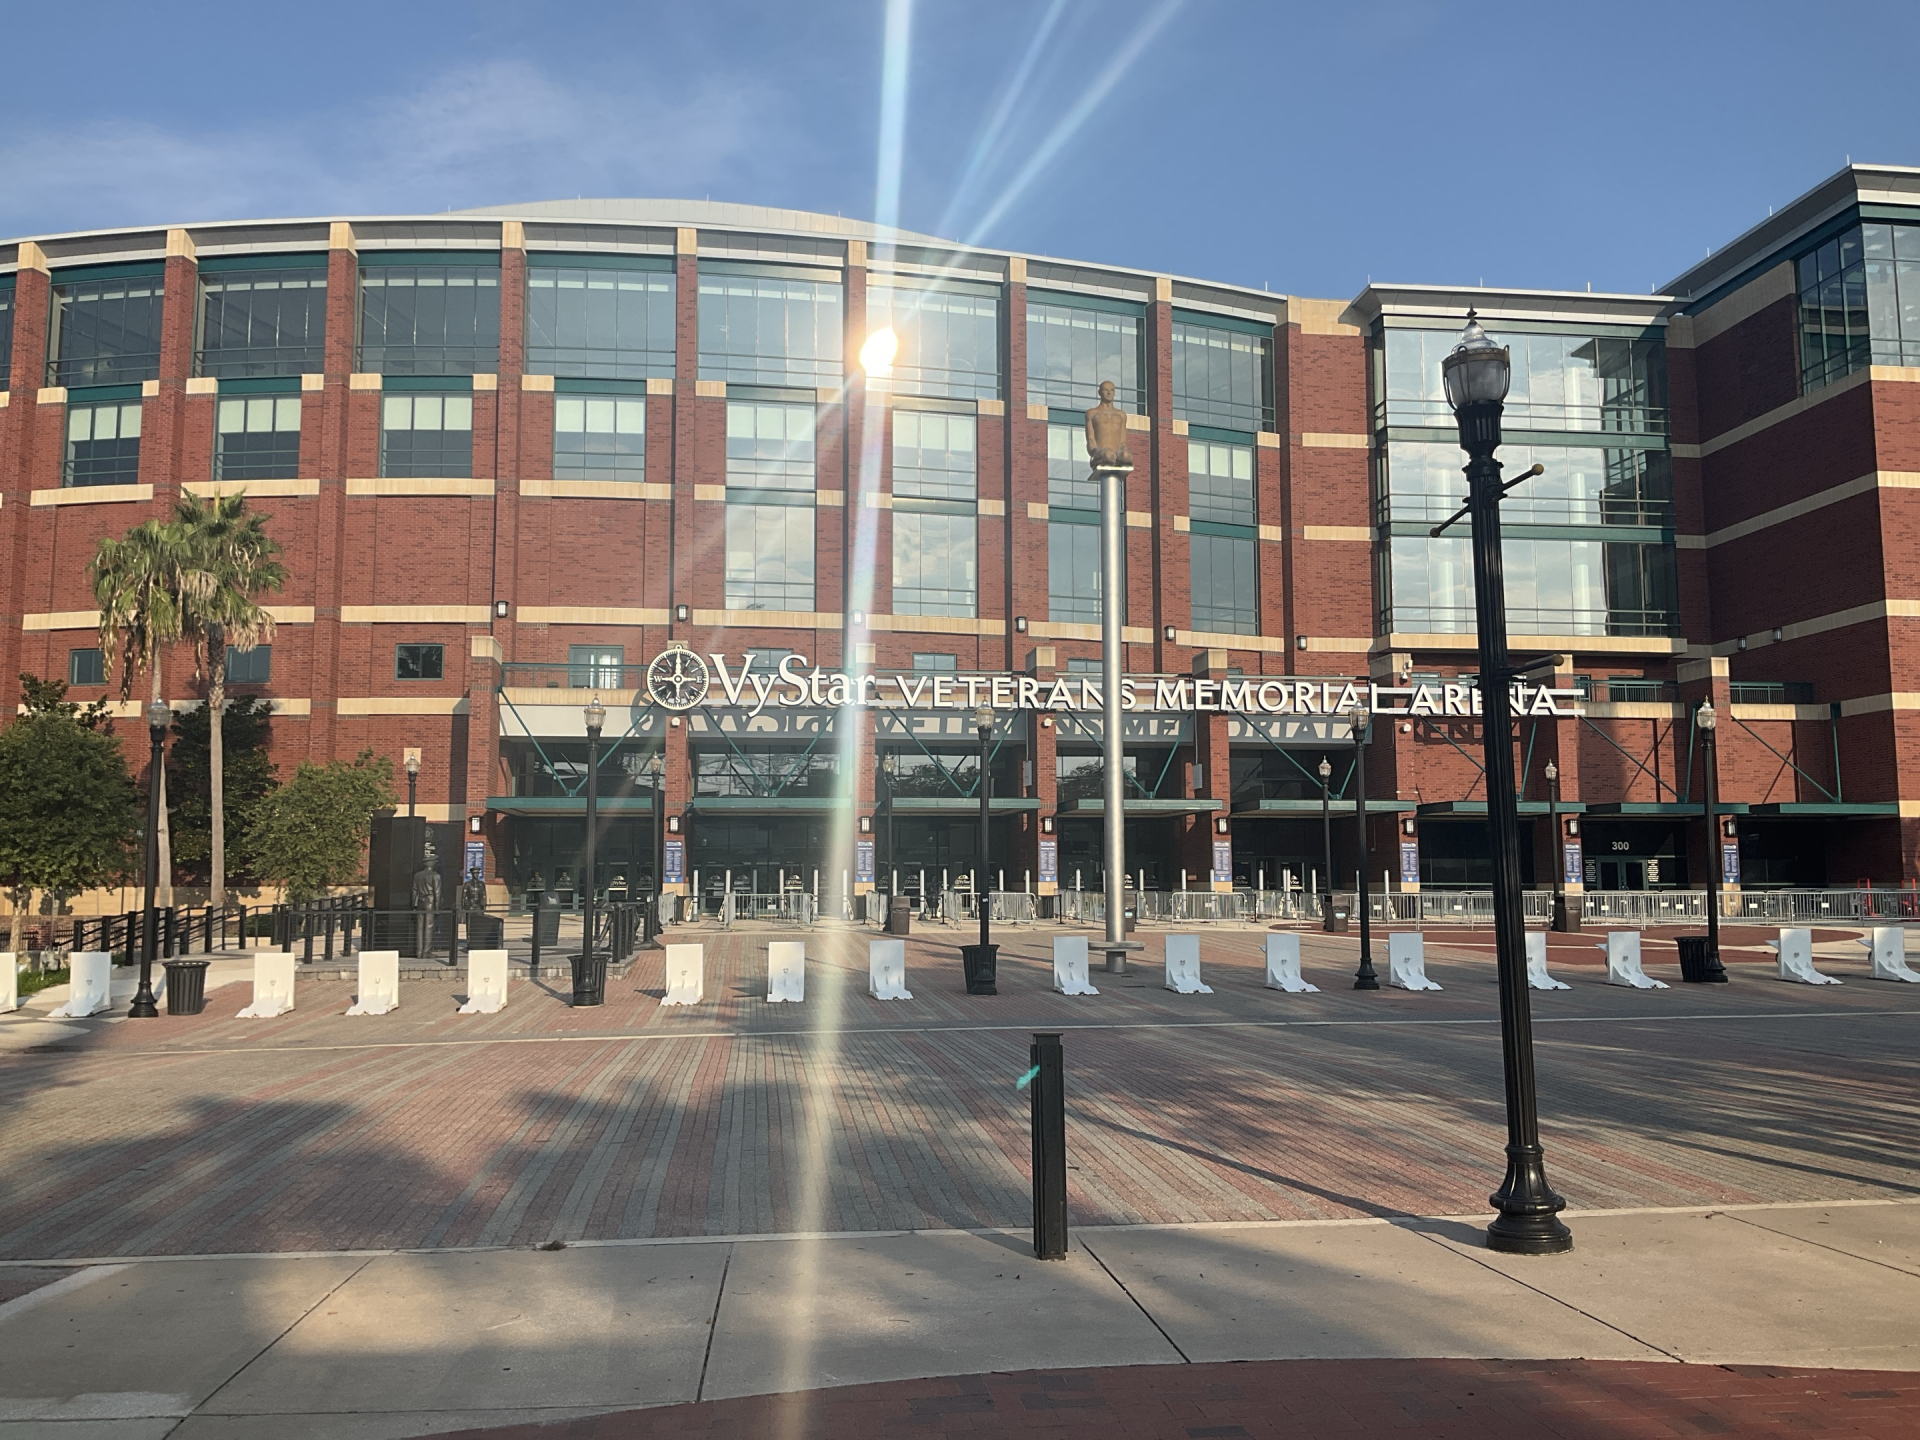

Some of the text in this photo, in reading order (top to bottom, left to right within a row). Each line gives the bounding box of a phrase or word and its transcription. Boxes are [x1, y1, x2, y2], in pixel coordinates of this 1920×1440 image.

[709, 653, 876, 718] VyStar
[895, 675, 1137, 710] VETERANS
[1155, 679, 1389, 713] MEMORIAL
[1611, 841, 1630, 851] 300
